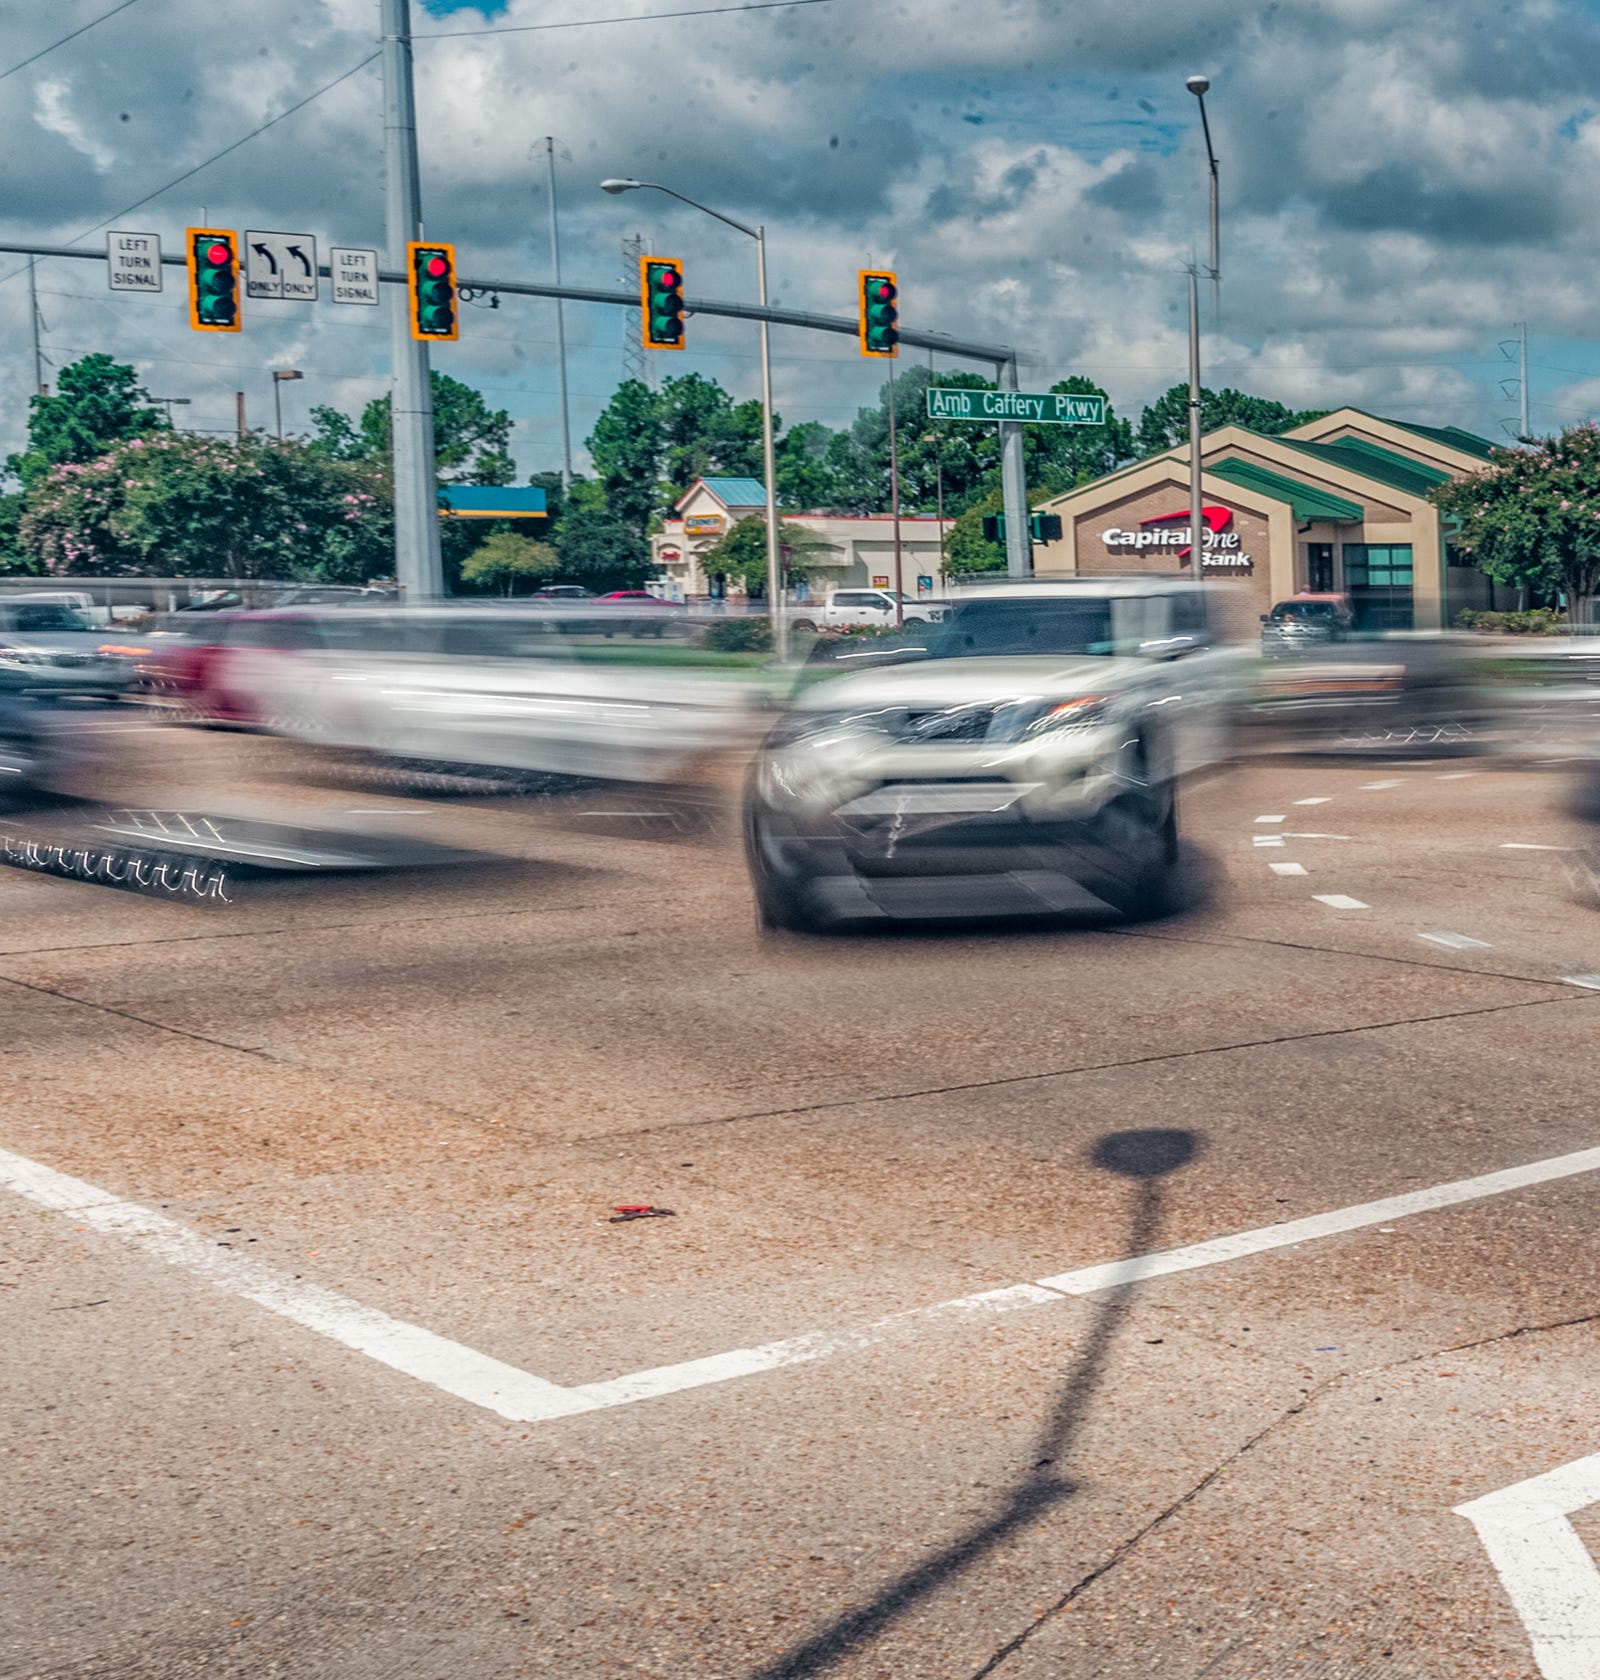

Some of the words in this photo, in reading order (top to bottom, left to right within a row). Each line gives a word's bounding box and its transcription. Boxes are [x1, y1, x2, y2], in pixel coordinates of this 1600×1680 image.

[119, 238, 149, 251] LEFT
[118, 255, 151, 269] TURN
[340, 254, 366, 267] LEFT
[113, 272, 158, 286] SIGNAL
[340, 270, 369, 283] TURN
[248, 280, 280, 292] ONLY
[284, 282, 314, 294] ONLY
[336, 286, 375, 300] SIGNAL
[933, 389, 971, 413] Amb
[983, 392, 1044, 420] Caffery
[1055, 395, 1099, 422] Pkwy
[1201, 551, 1251, 567] Bank
